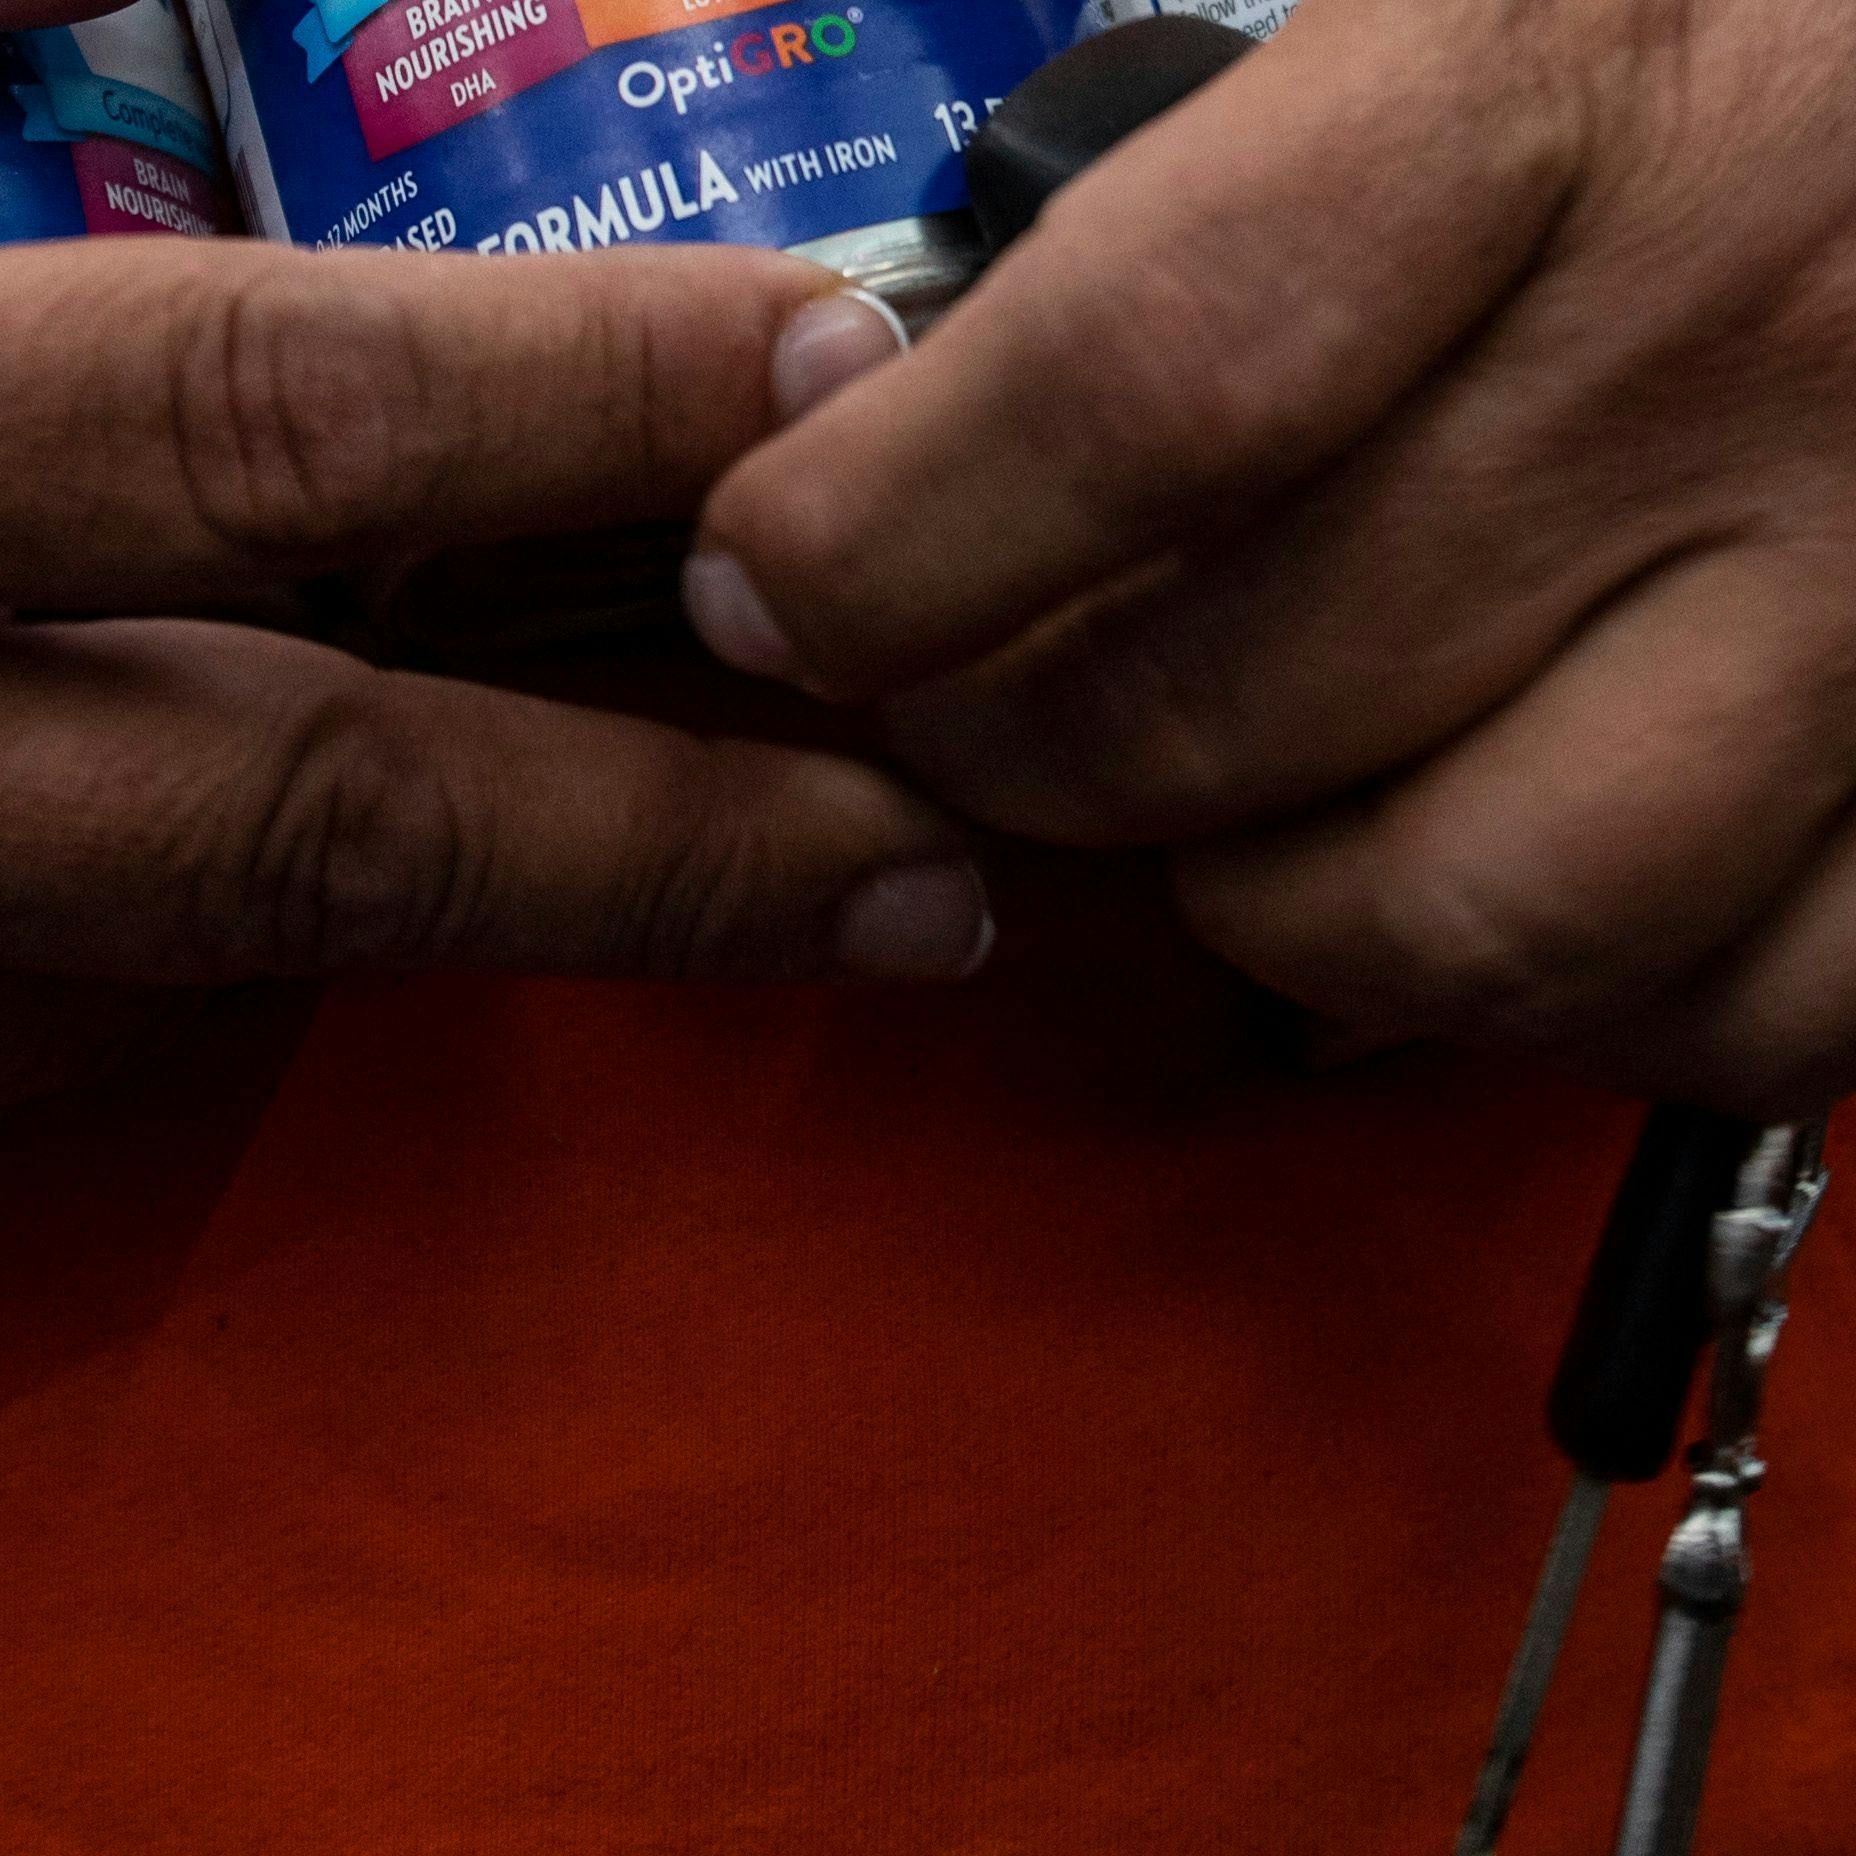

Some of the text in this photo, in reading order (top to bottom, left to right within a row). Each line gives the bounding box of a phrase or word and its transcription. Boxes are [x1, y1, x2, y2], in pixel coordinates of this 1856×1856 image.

[1242, 14, 1280, 42] eed
[449, 66, 497, 110] DHA
[101, 89, 194, 152] Comple
[132, 157, 191, 204] BRAIN
[744, 144, 825, 196] WITH
[829, 132, 898, 176] IRON
[103, 180, 215, 236] NOURISHI
[342, 170, 419, 244] MONTHS
